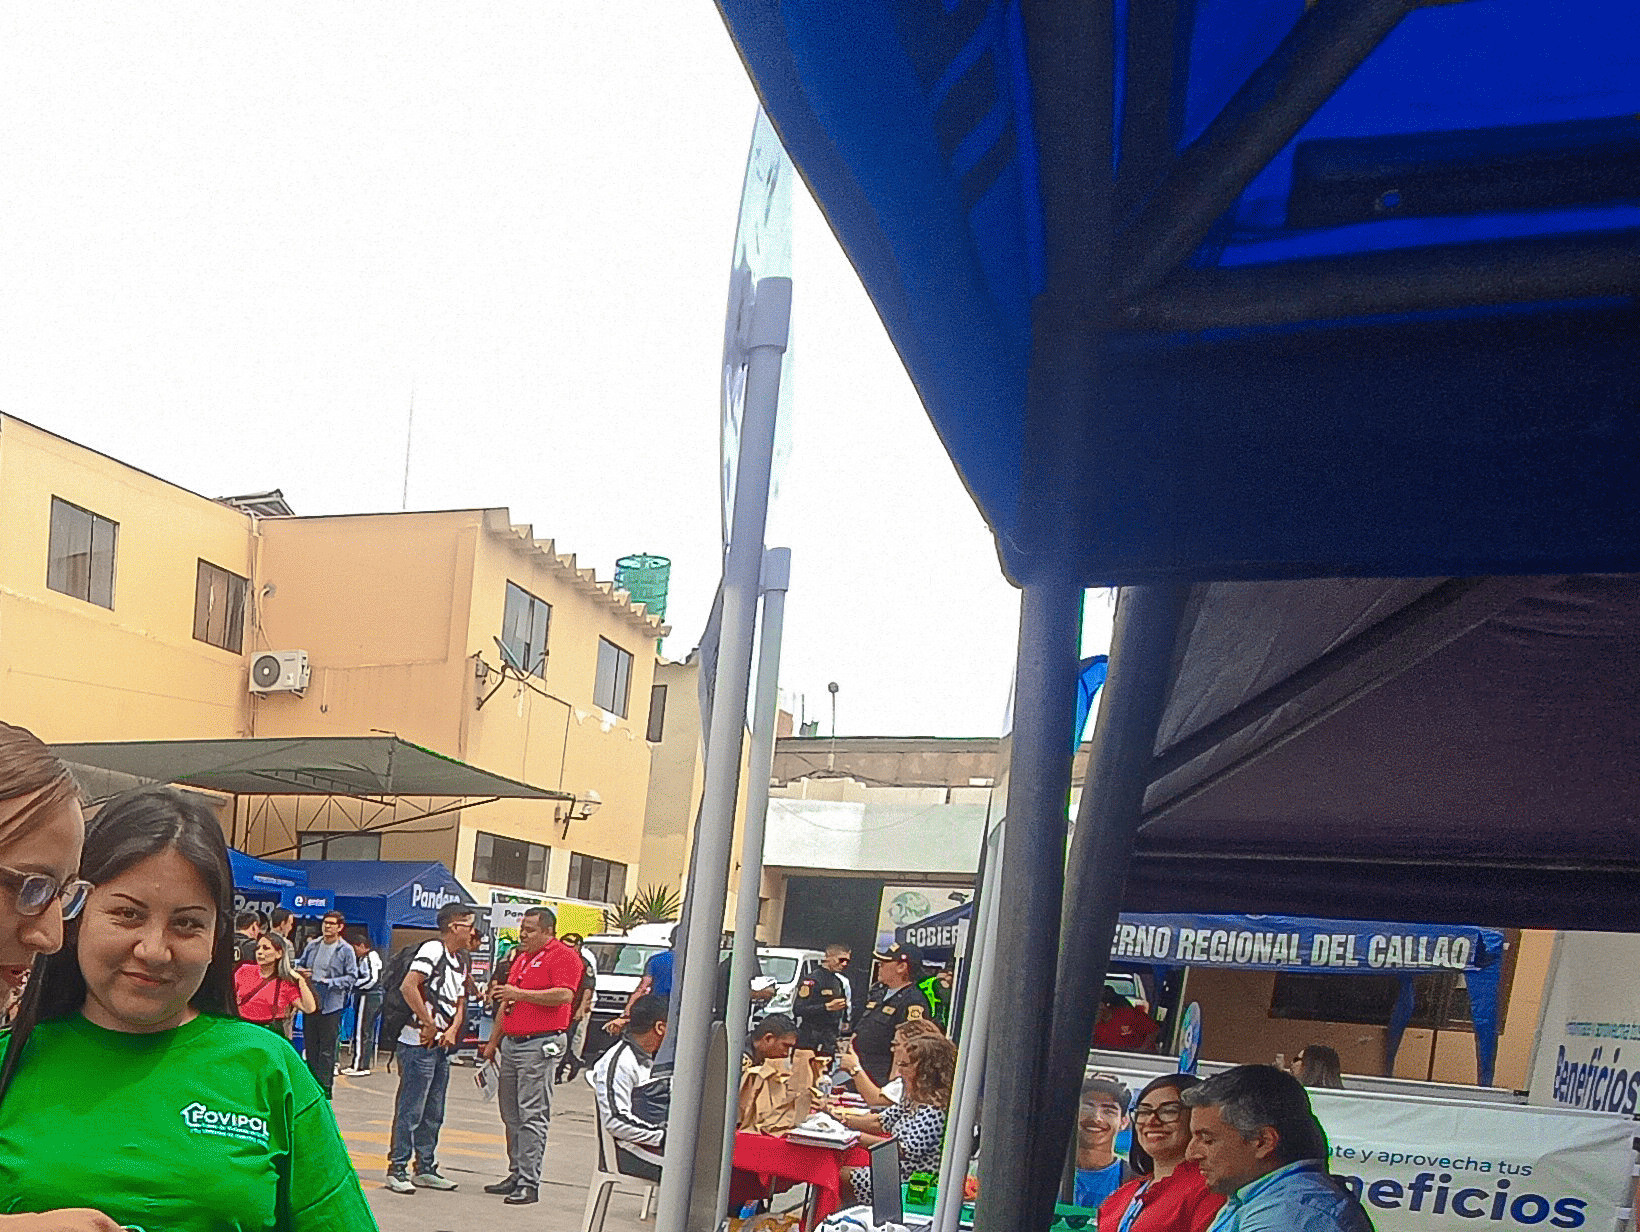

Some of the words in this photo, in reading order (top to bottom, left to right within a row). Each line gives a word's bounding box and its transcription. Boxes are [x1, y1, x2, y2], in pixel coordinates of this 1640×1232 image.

[905, 925, 959, 948] GOBIER
[1175, 927, 1302, 966] REGIONAL
[1310, 933, 1360, 967] DEL
[1367, 934, 1471, 970] CALLAO
[188, 1105, 270, 1138] FOVIPOL
[1359, 1150, 1374, 1163] y
[1377, 1149, 1492, 1174] aprovecha
[1498, 1159, 1534, 1177] tus
